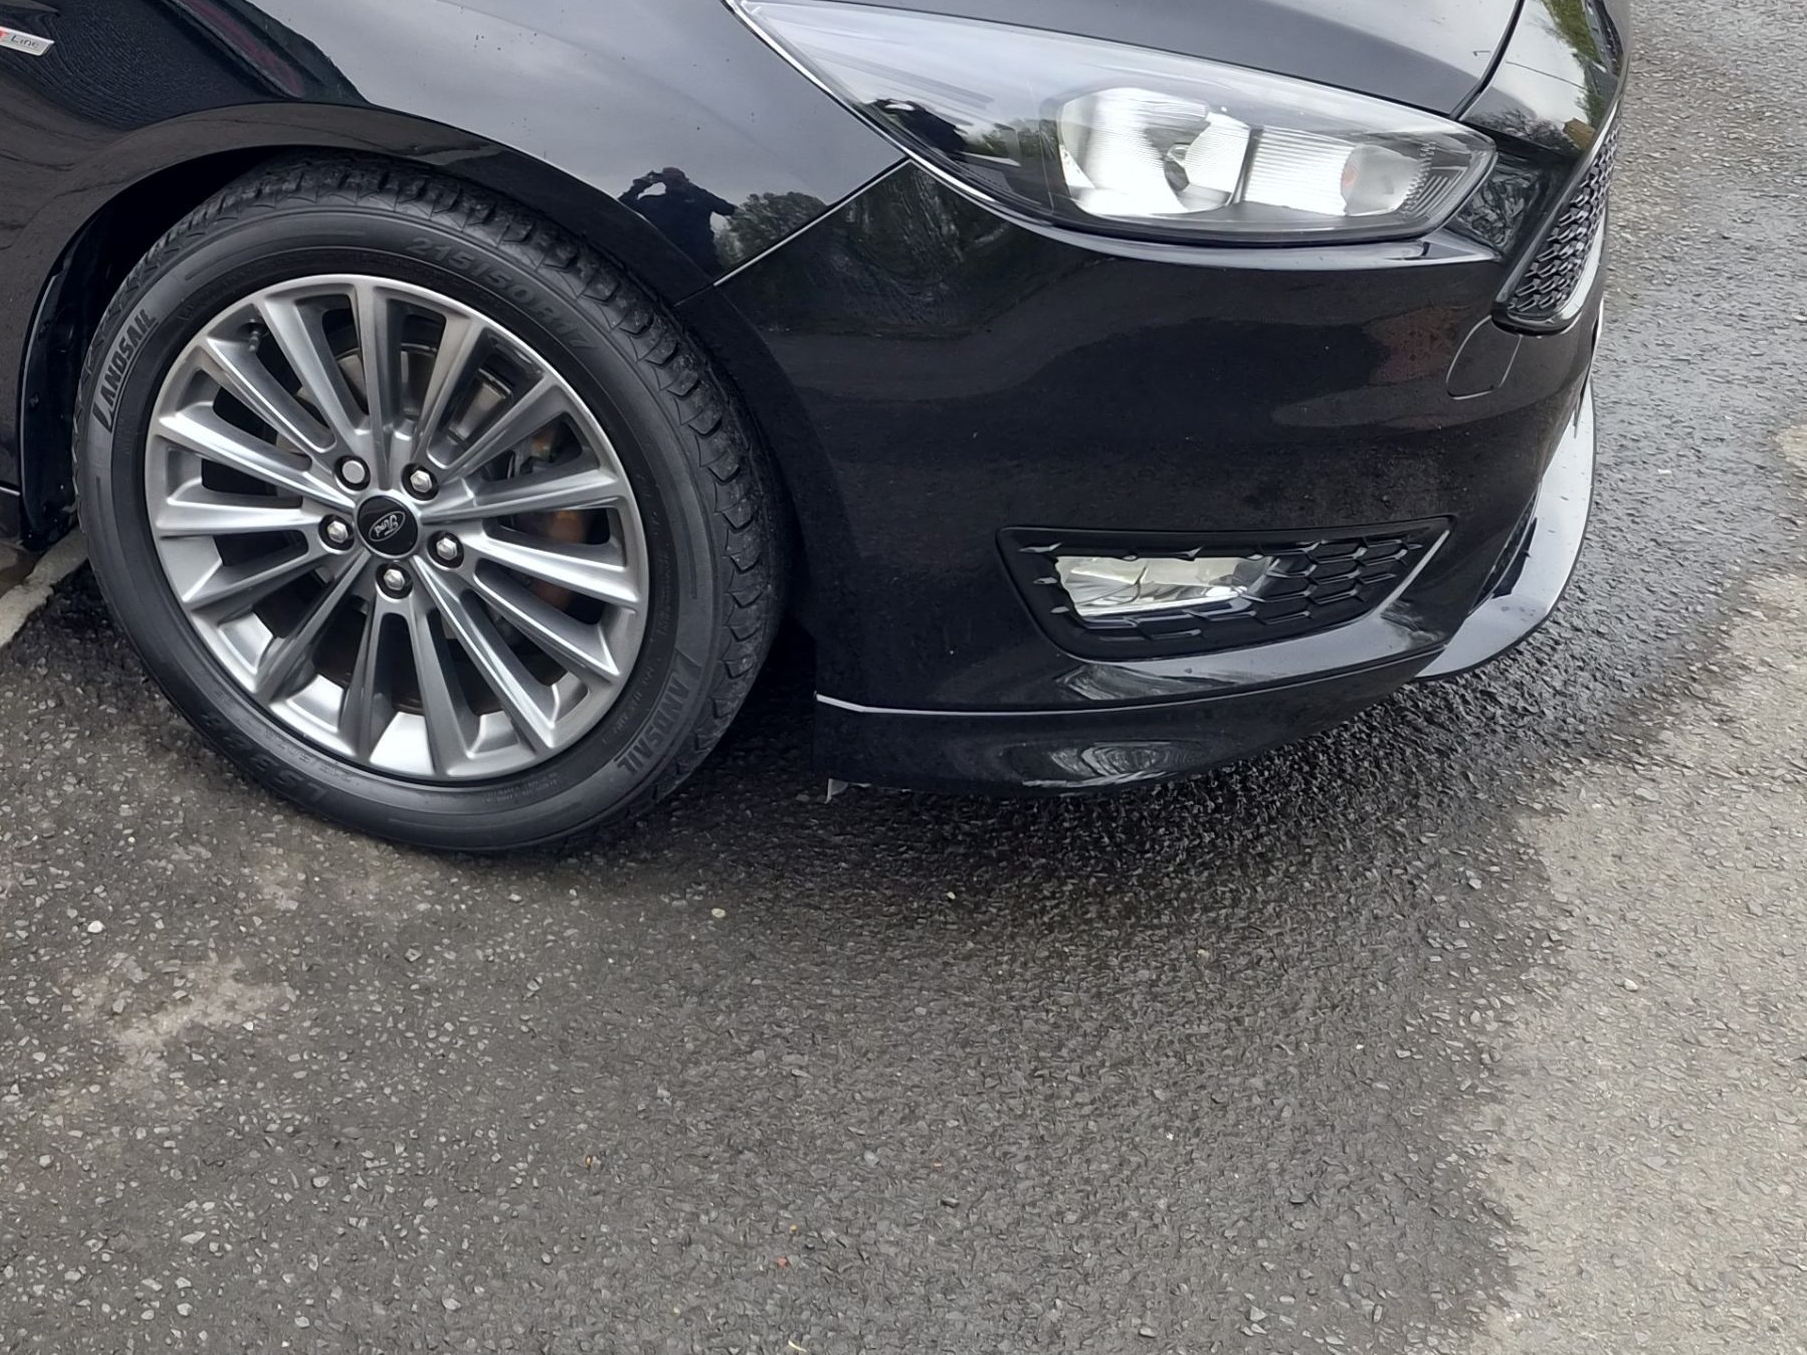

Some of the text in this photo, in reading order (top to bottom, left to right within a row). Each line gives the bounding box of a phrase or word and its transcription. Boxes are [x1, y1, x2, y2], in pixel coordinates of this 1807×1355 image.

[405, 236, 597, 350] 215/50R17
[92, 307, 158, 434] LANDSAIL
[615, 646, 704, 774] LANDSAIL
